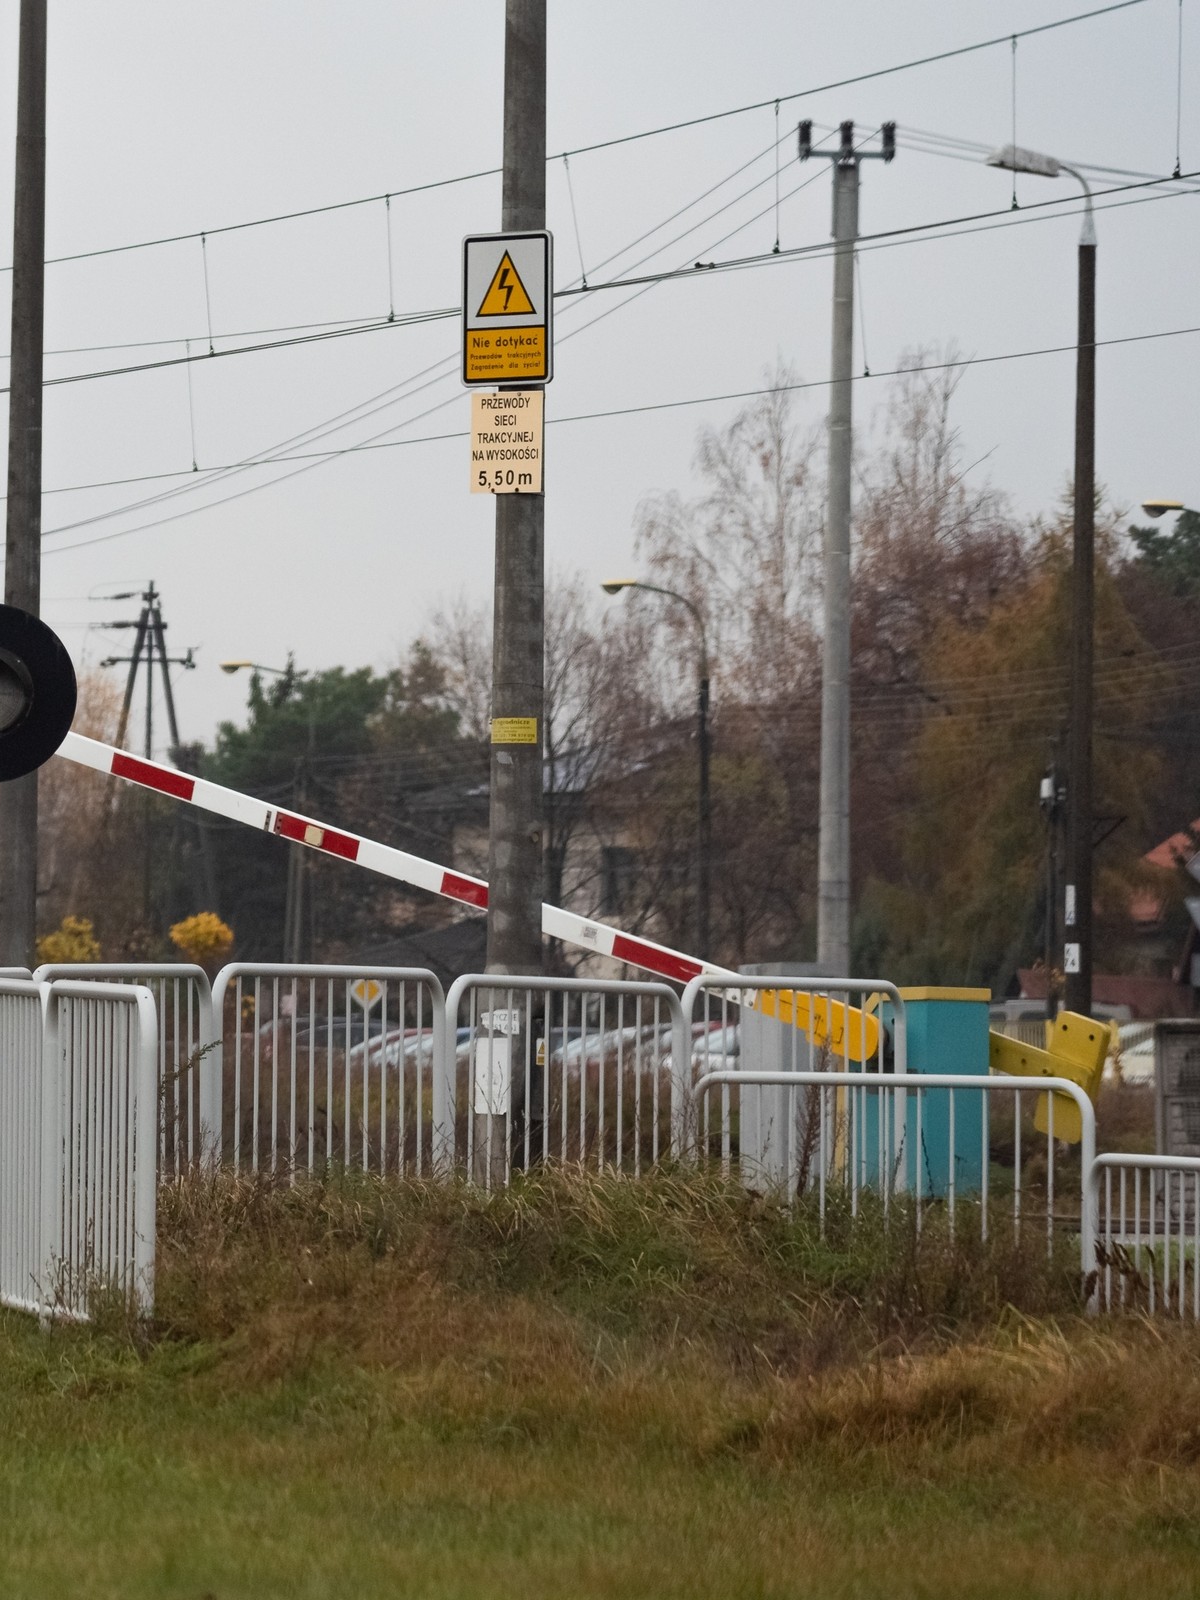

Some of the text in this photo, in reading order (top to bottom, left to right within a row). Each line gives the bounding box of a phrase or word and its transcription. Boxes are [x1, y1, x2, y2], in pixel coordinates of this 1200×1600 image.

[472, 334, 538, 349] Nie dotykać
[481, 397, 530, 409] PRZEWODY
[494, 415, 517, 426] SIECI
[478, 432, 534, 443] TRAKCYJNEJ
[472, 446, 539, 461] NA WYSOKOŚCI
[518, 472, 532, 485] m
